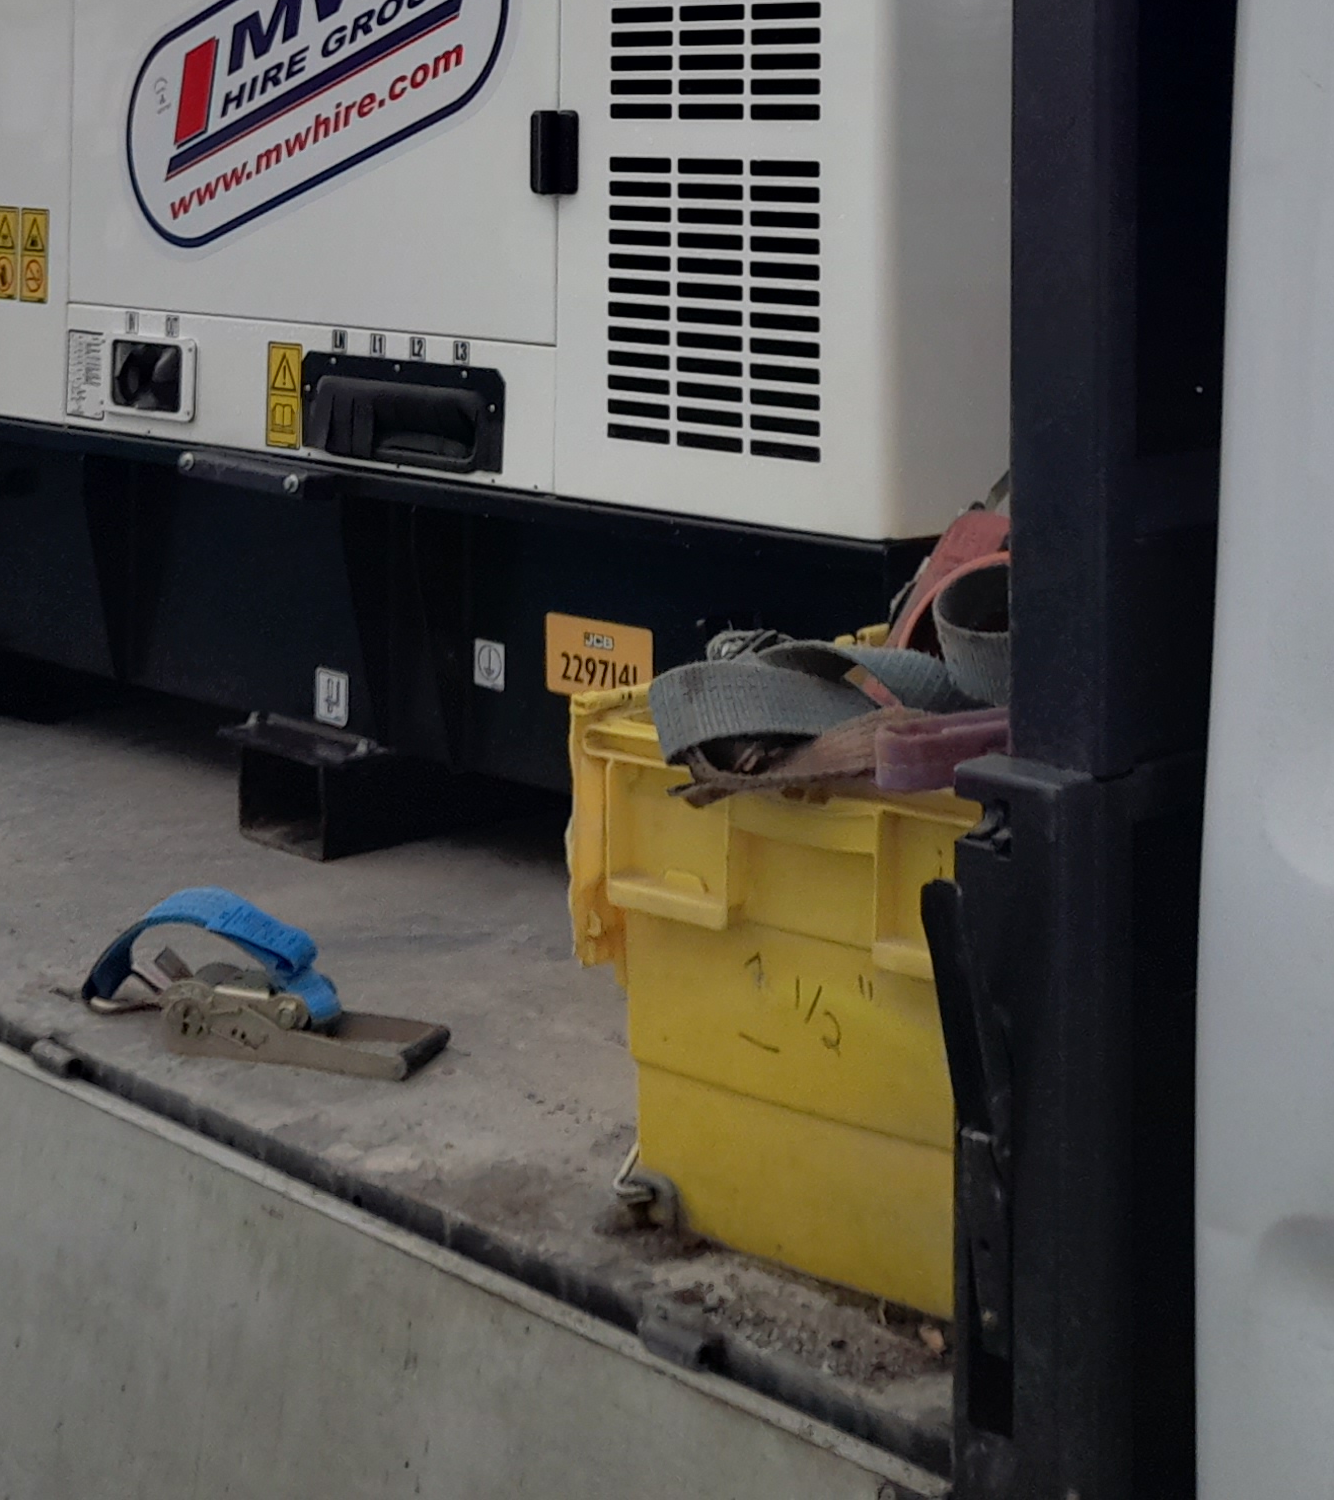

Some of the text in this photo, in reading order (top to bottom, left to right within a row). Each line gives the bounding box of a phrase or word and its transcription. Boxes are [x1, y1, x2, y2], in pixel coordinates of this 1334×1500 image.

[220, 46, 309, 118] HIRE
[169, 43, 464, 220] www.mwhire.com
[585, 633, 614, 650] JCB
